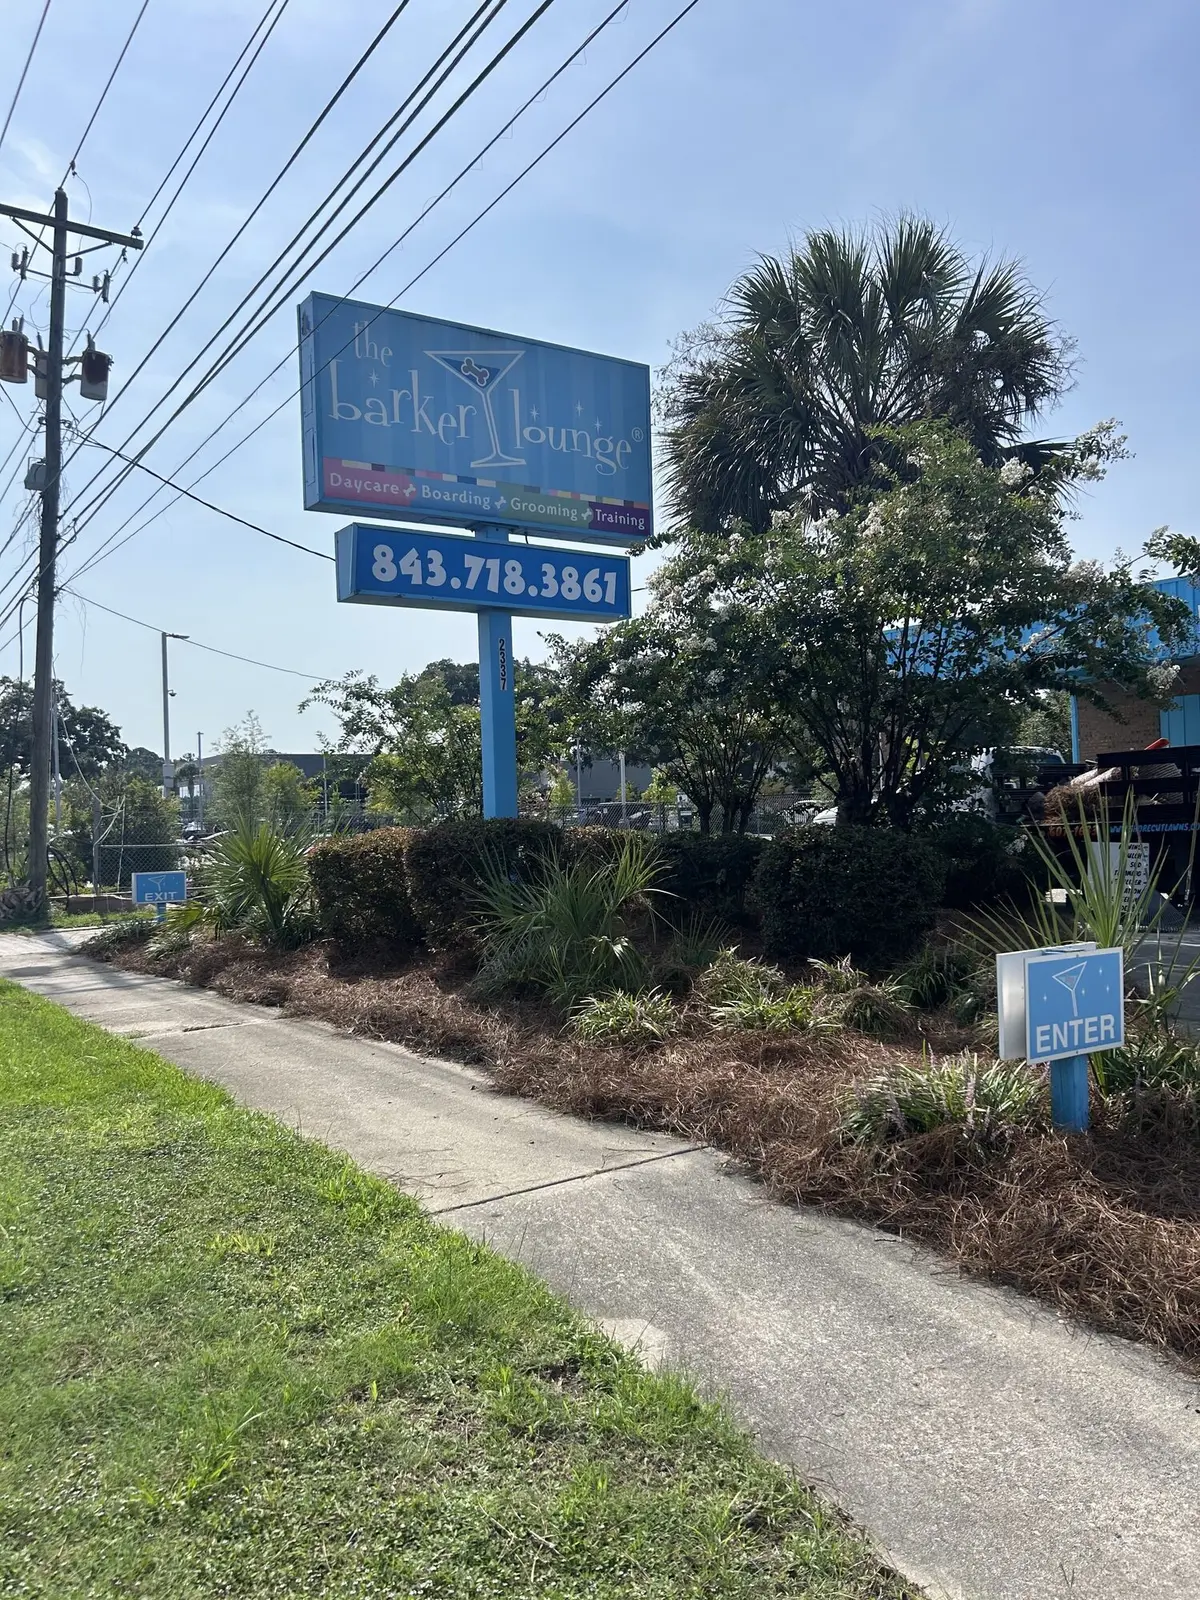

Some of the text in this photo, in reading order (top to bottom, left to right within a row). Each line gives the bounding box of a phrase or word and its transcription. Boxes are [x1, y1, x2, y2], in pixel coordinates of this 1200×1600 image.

[352, 320, 393, 367] the
[328, 357, 477, 445] barker
[330, 472, 645, 530] Daycare Boarding Grooming Training
[371, 544, 617, 605] 843.718.3861
[499, 638, 507, 690] 2337
[144, 891, 178, 902] EXIT
[1036, 1013, 1115, 1054] ENTER
